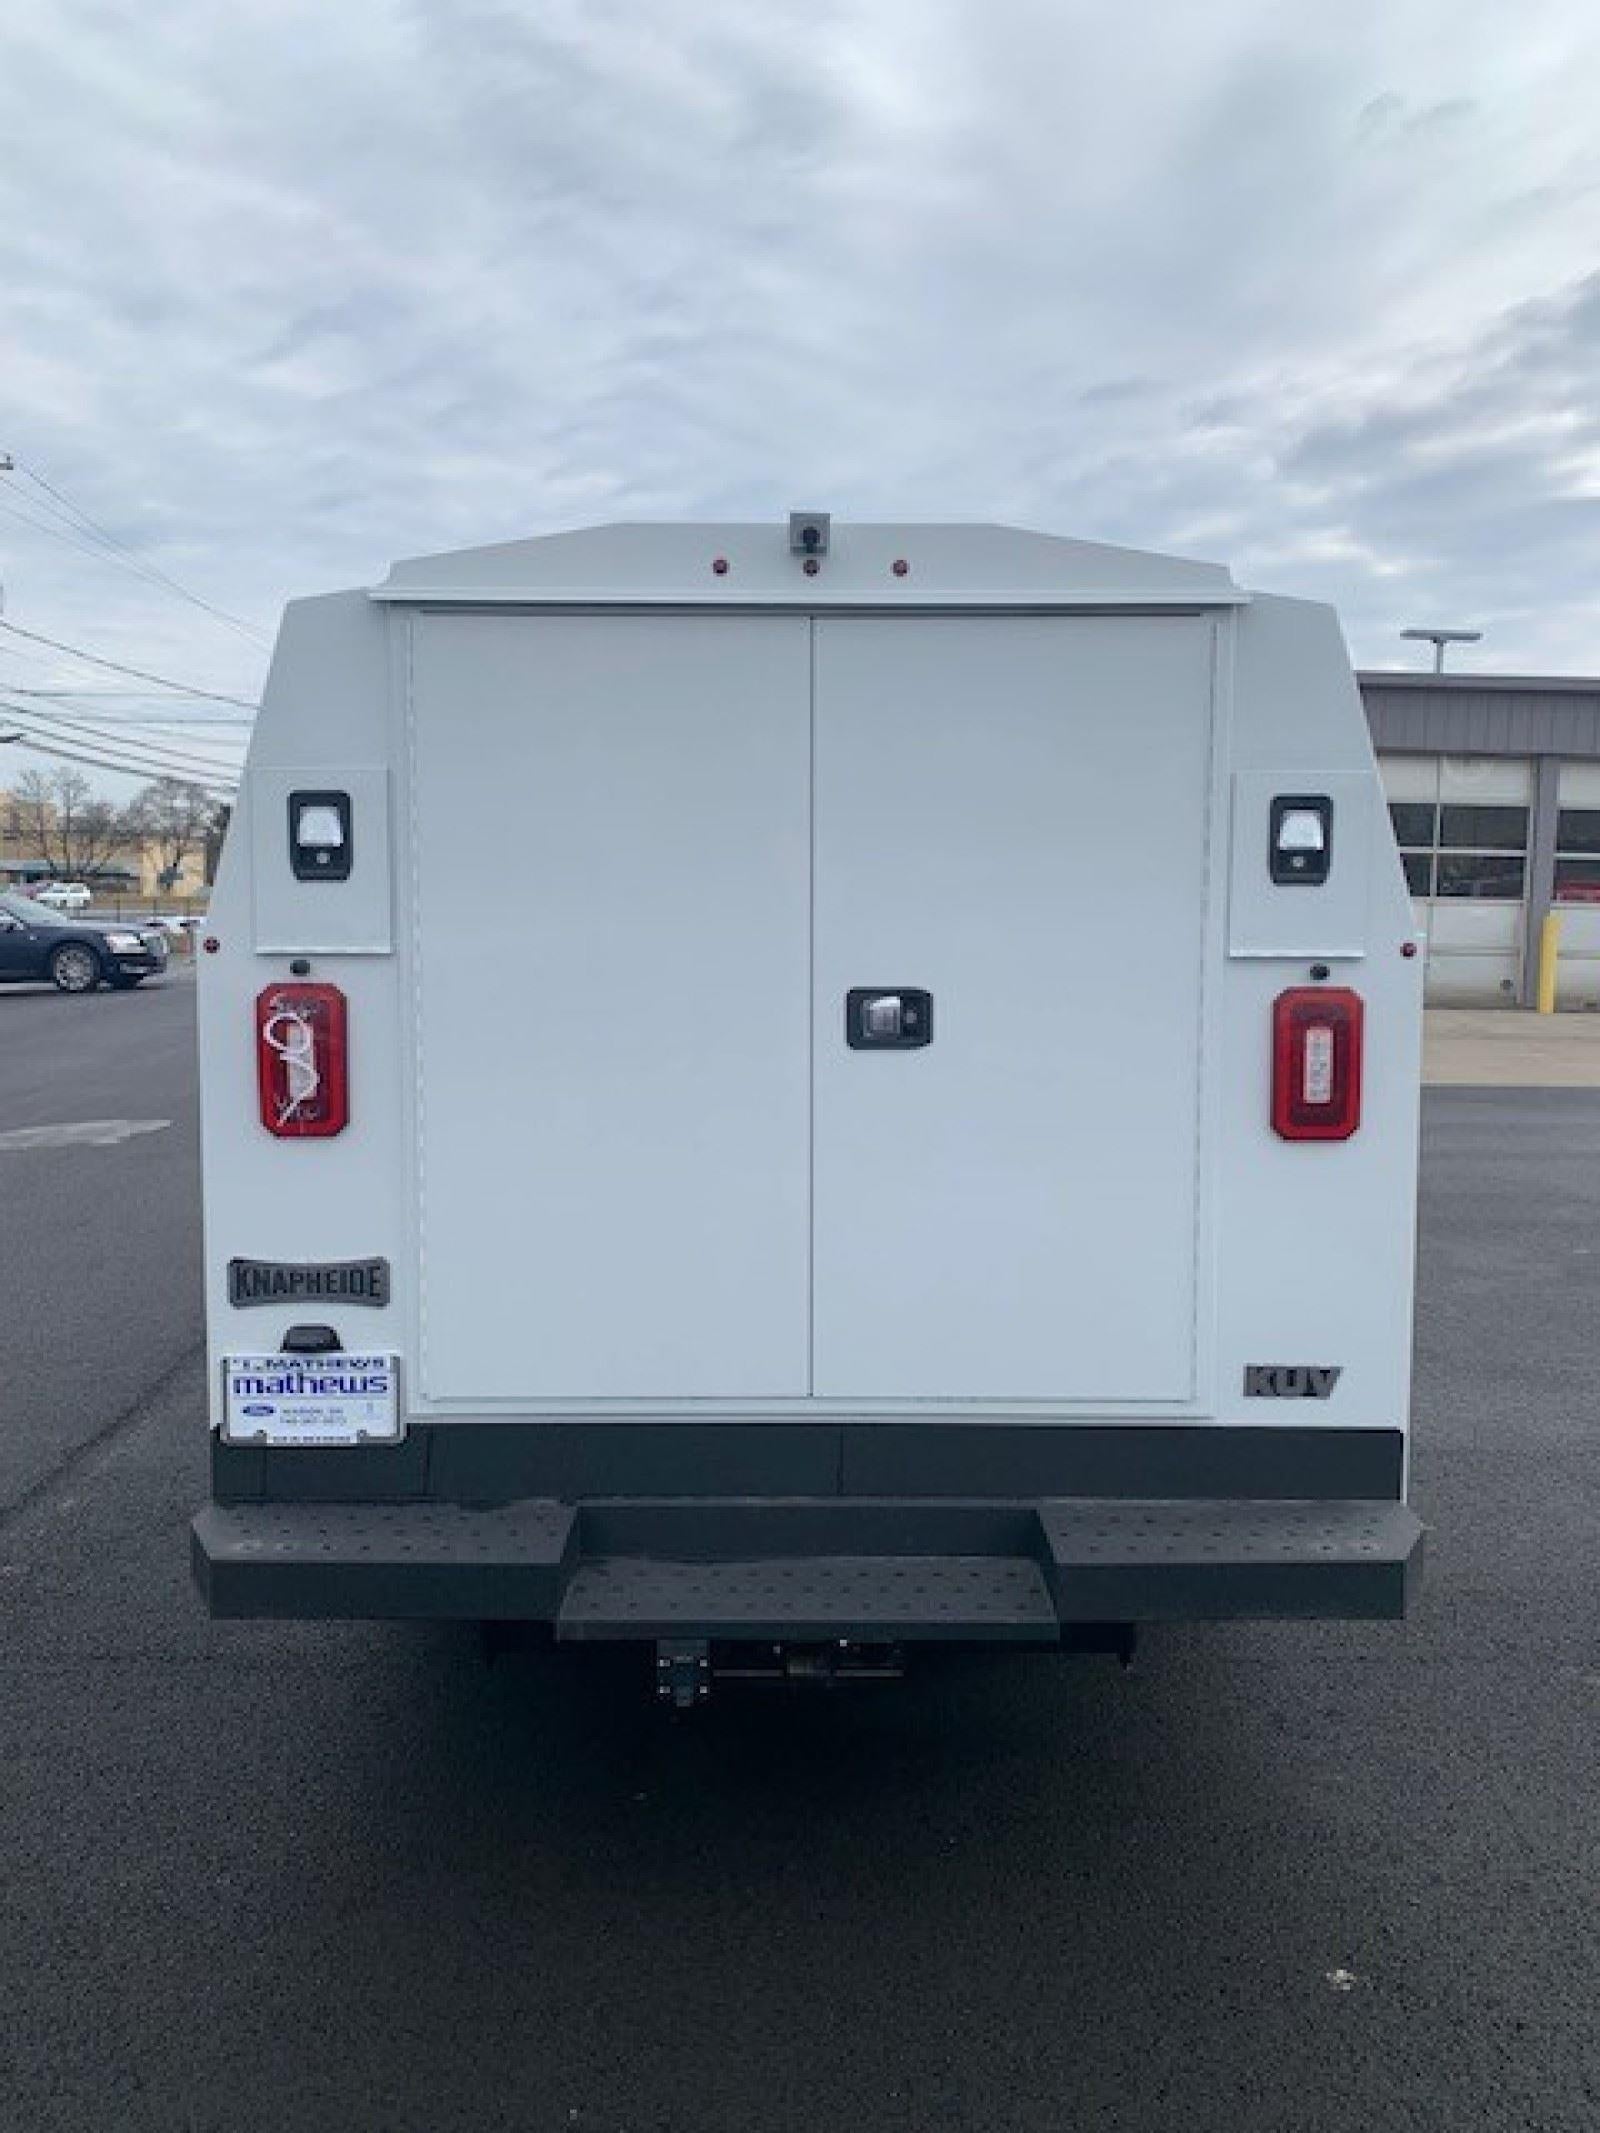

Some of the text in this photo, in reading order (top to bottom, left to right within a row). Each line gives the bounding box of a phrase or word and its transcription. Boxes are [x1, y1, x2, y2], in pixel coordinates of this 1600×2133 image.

[235, 1264, 382, 1300] KNAPHEIDE
[232, 1373, 389, 1394] mathews
[1245, 1366, 1342, 1398] KUV
